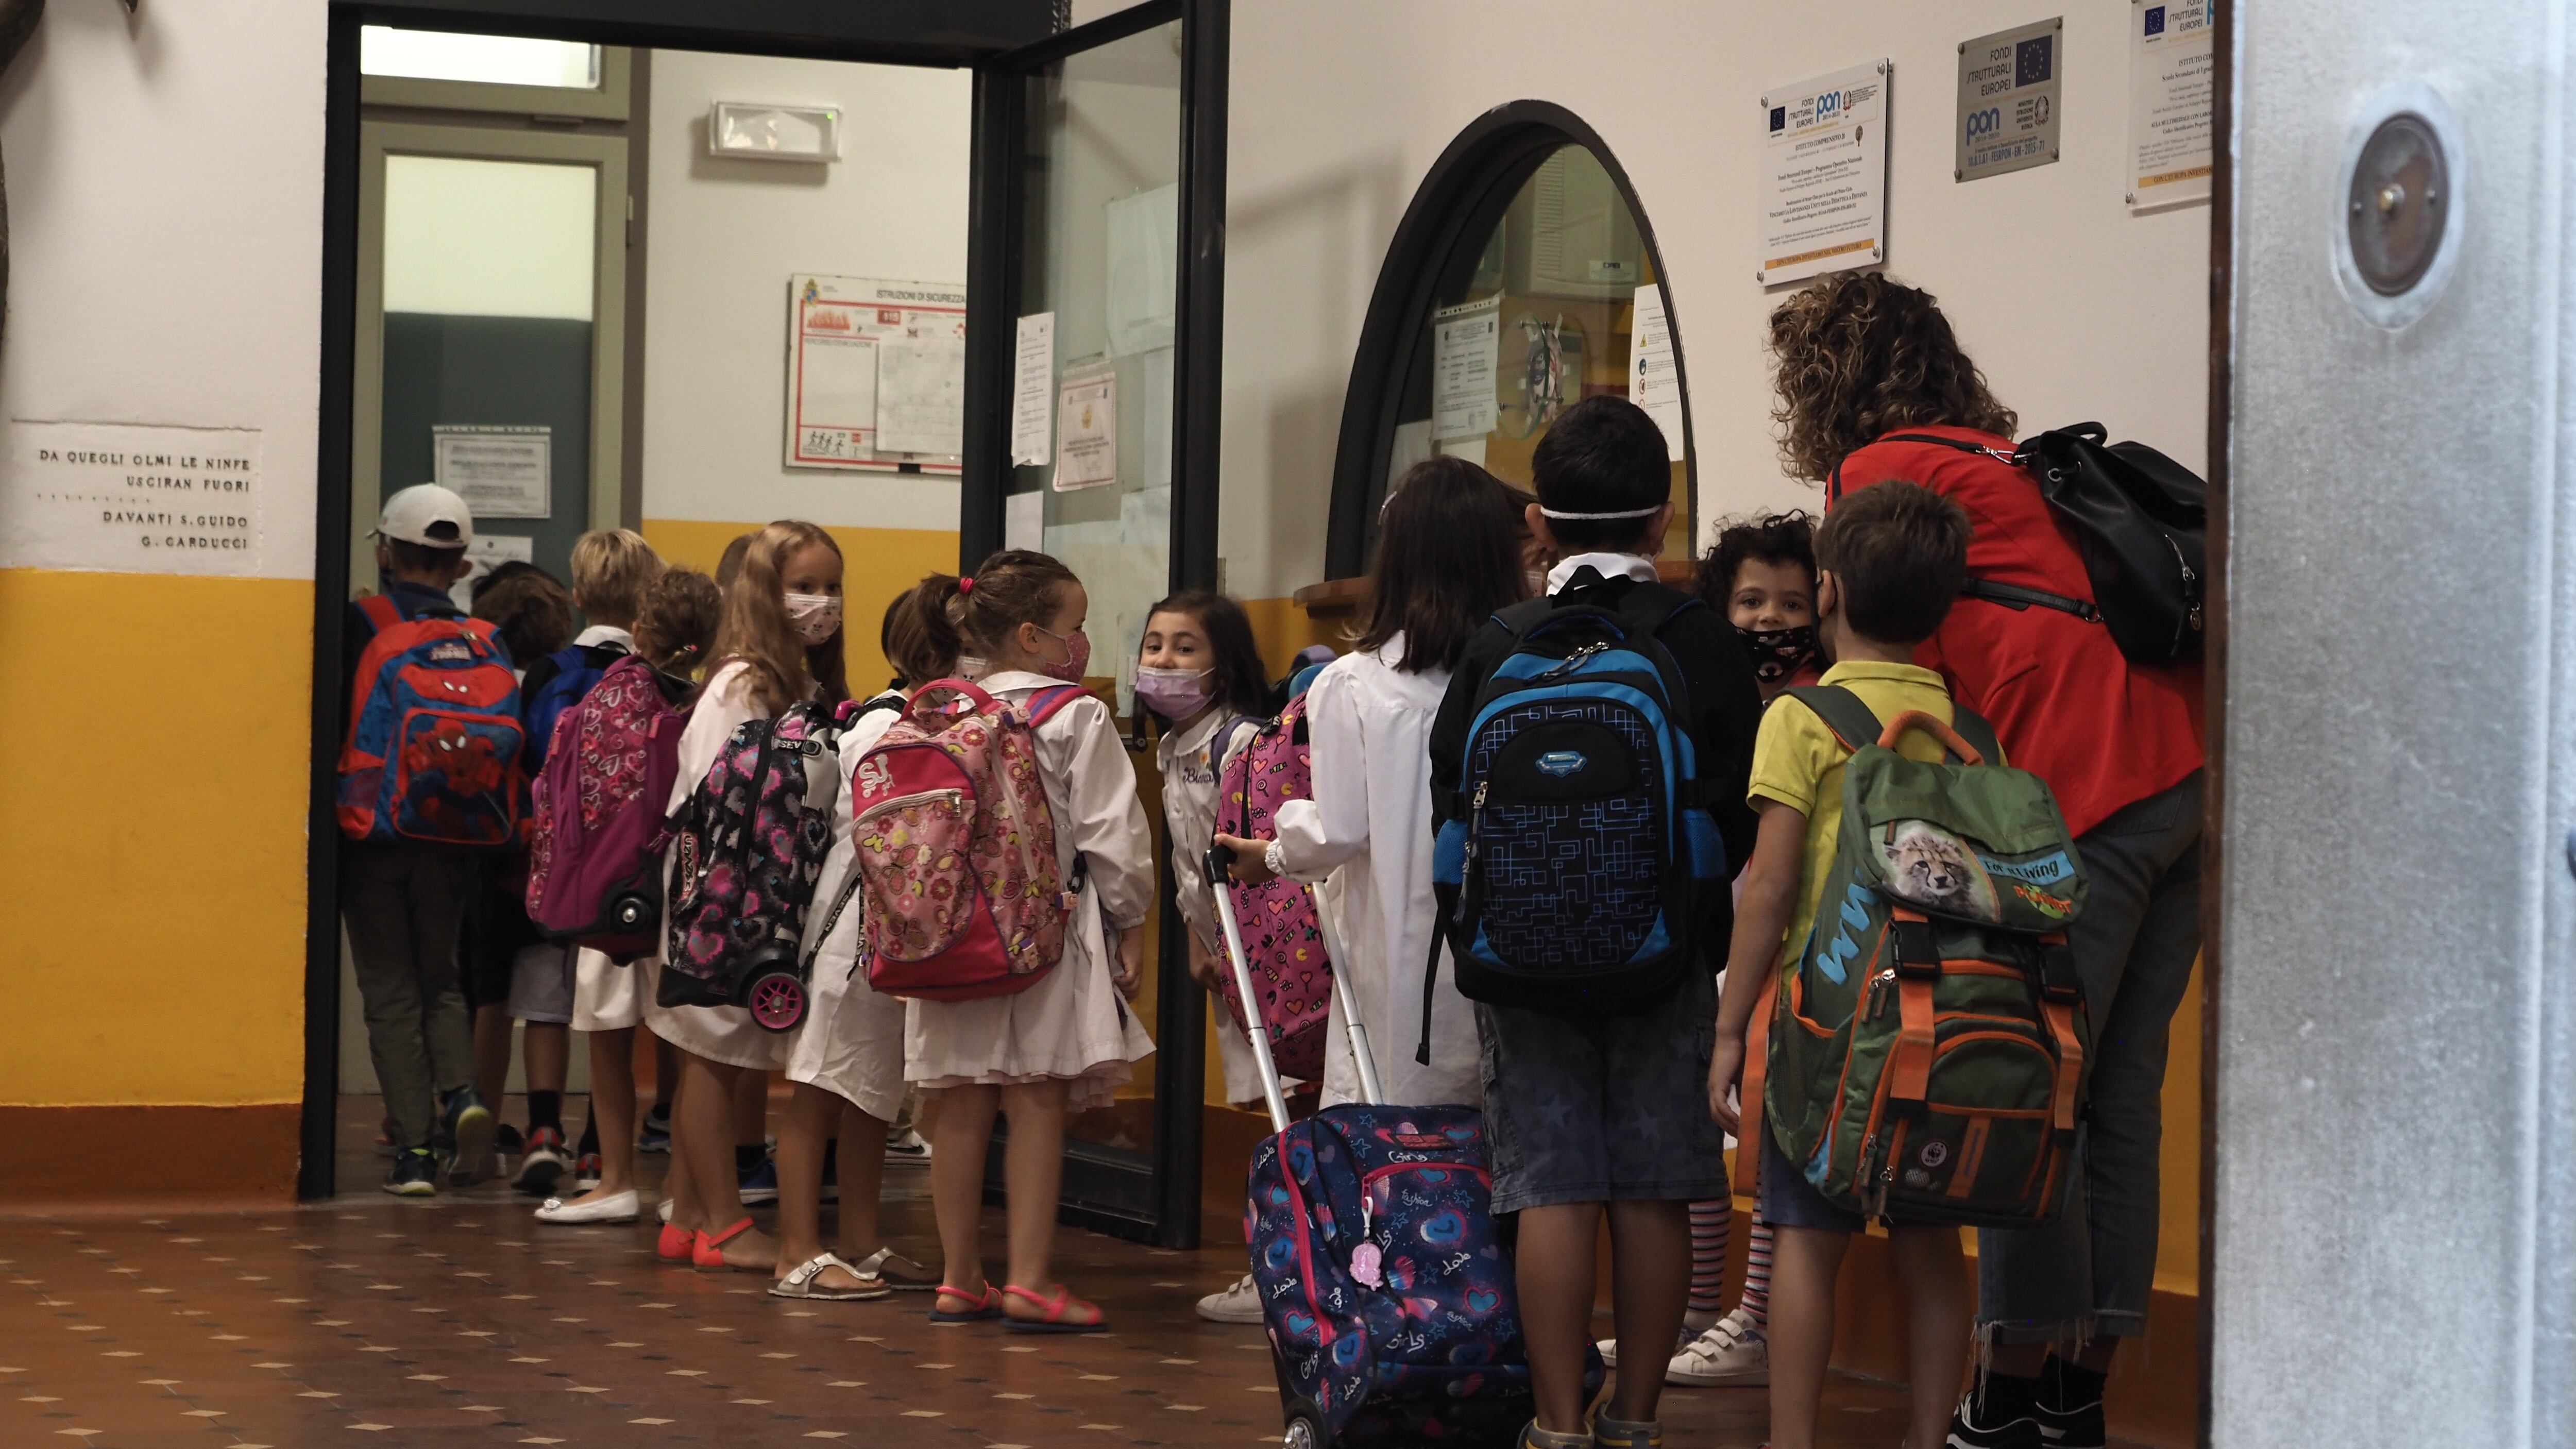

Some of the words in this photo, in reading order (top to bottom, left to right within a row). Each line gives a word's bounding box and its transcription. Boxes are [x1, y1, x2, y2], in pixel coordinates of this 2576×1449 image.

[2169, 7, 2202, 23] STRUTTURALI
[2180, 18, 2202, 31] EUROPEI
[1990, 46, 2011, 61] FONDI
[2179, 55, 2202, 66] ISTITUTO
[1967, 62, 2011, 83] STRUTTURALI
[1981, 78, 2010, 96] EUROPEI
[1802, 98, 1814, 106] FONDI
[1817, 93, 1841, 121] pon
[1788, 108, 1814, 120] STRUTTURALI
[1797, 118, 1814, 128] EUROPEI
[1967, 106, 1999, 145] pon
[1795, 142, 1814, 151] ISTITUTO
[1814, 135, 1841, 146] COMPRENSIVO
[877, 290, 916, 300] ISTRUZIONI
[918, 292, 924, 300] DI
[926, 293, 964, 303] SICUREZZA
[39, 450, 58, 461] DA
[67, 451, 124, 465] QUEGLI
[132, 454, 172, 466] OLMI
[181, 457, 197, 468] LE
[206, 458, 250, 471] NINFE
[127, 476, 192, 490] USCIRAN
[204, 479, 250, 493] FUORI
[103, 511, 172, 525] DAVANTI
[141, 536, 159, 548] G.
[166, 537, 247, 549] CARDUCCI
[1984, 861, 2003, 872] For
[2015, 860, 2059, 879] Living
[1443, 1252, 1471, 1275] Love
[1273, 1277, 1298, 1300] Love
